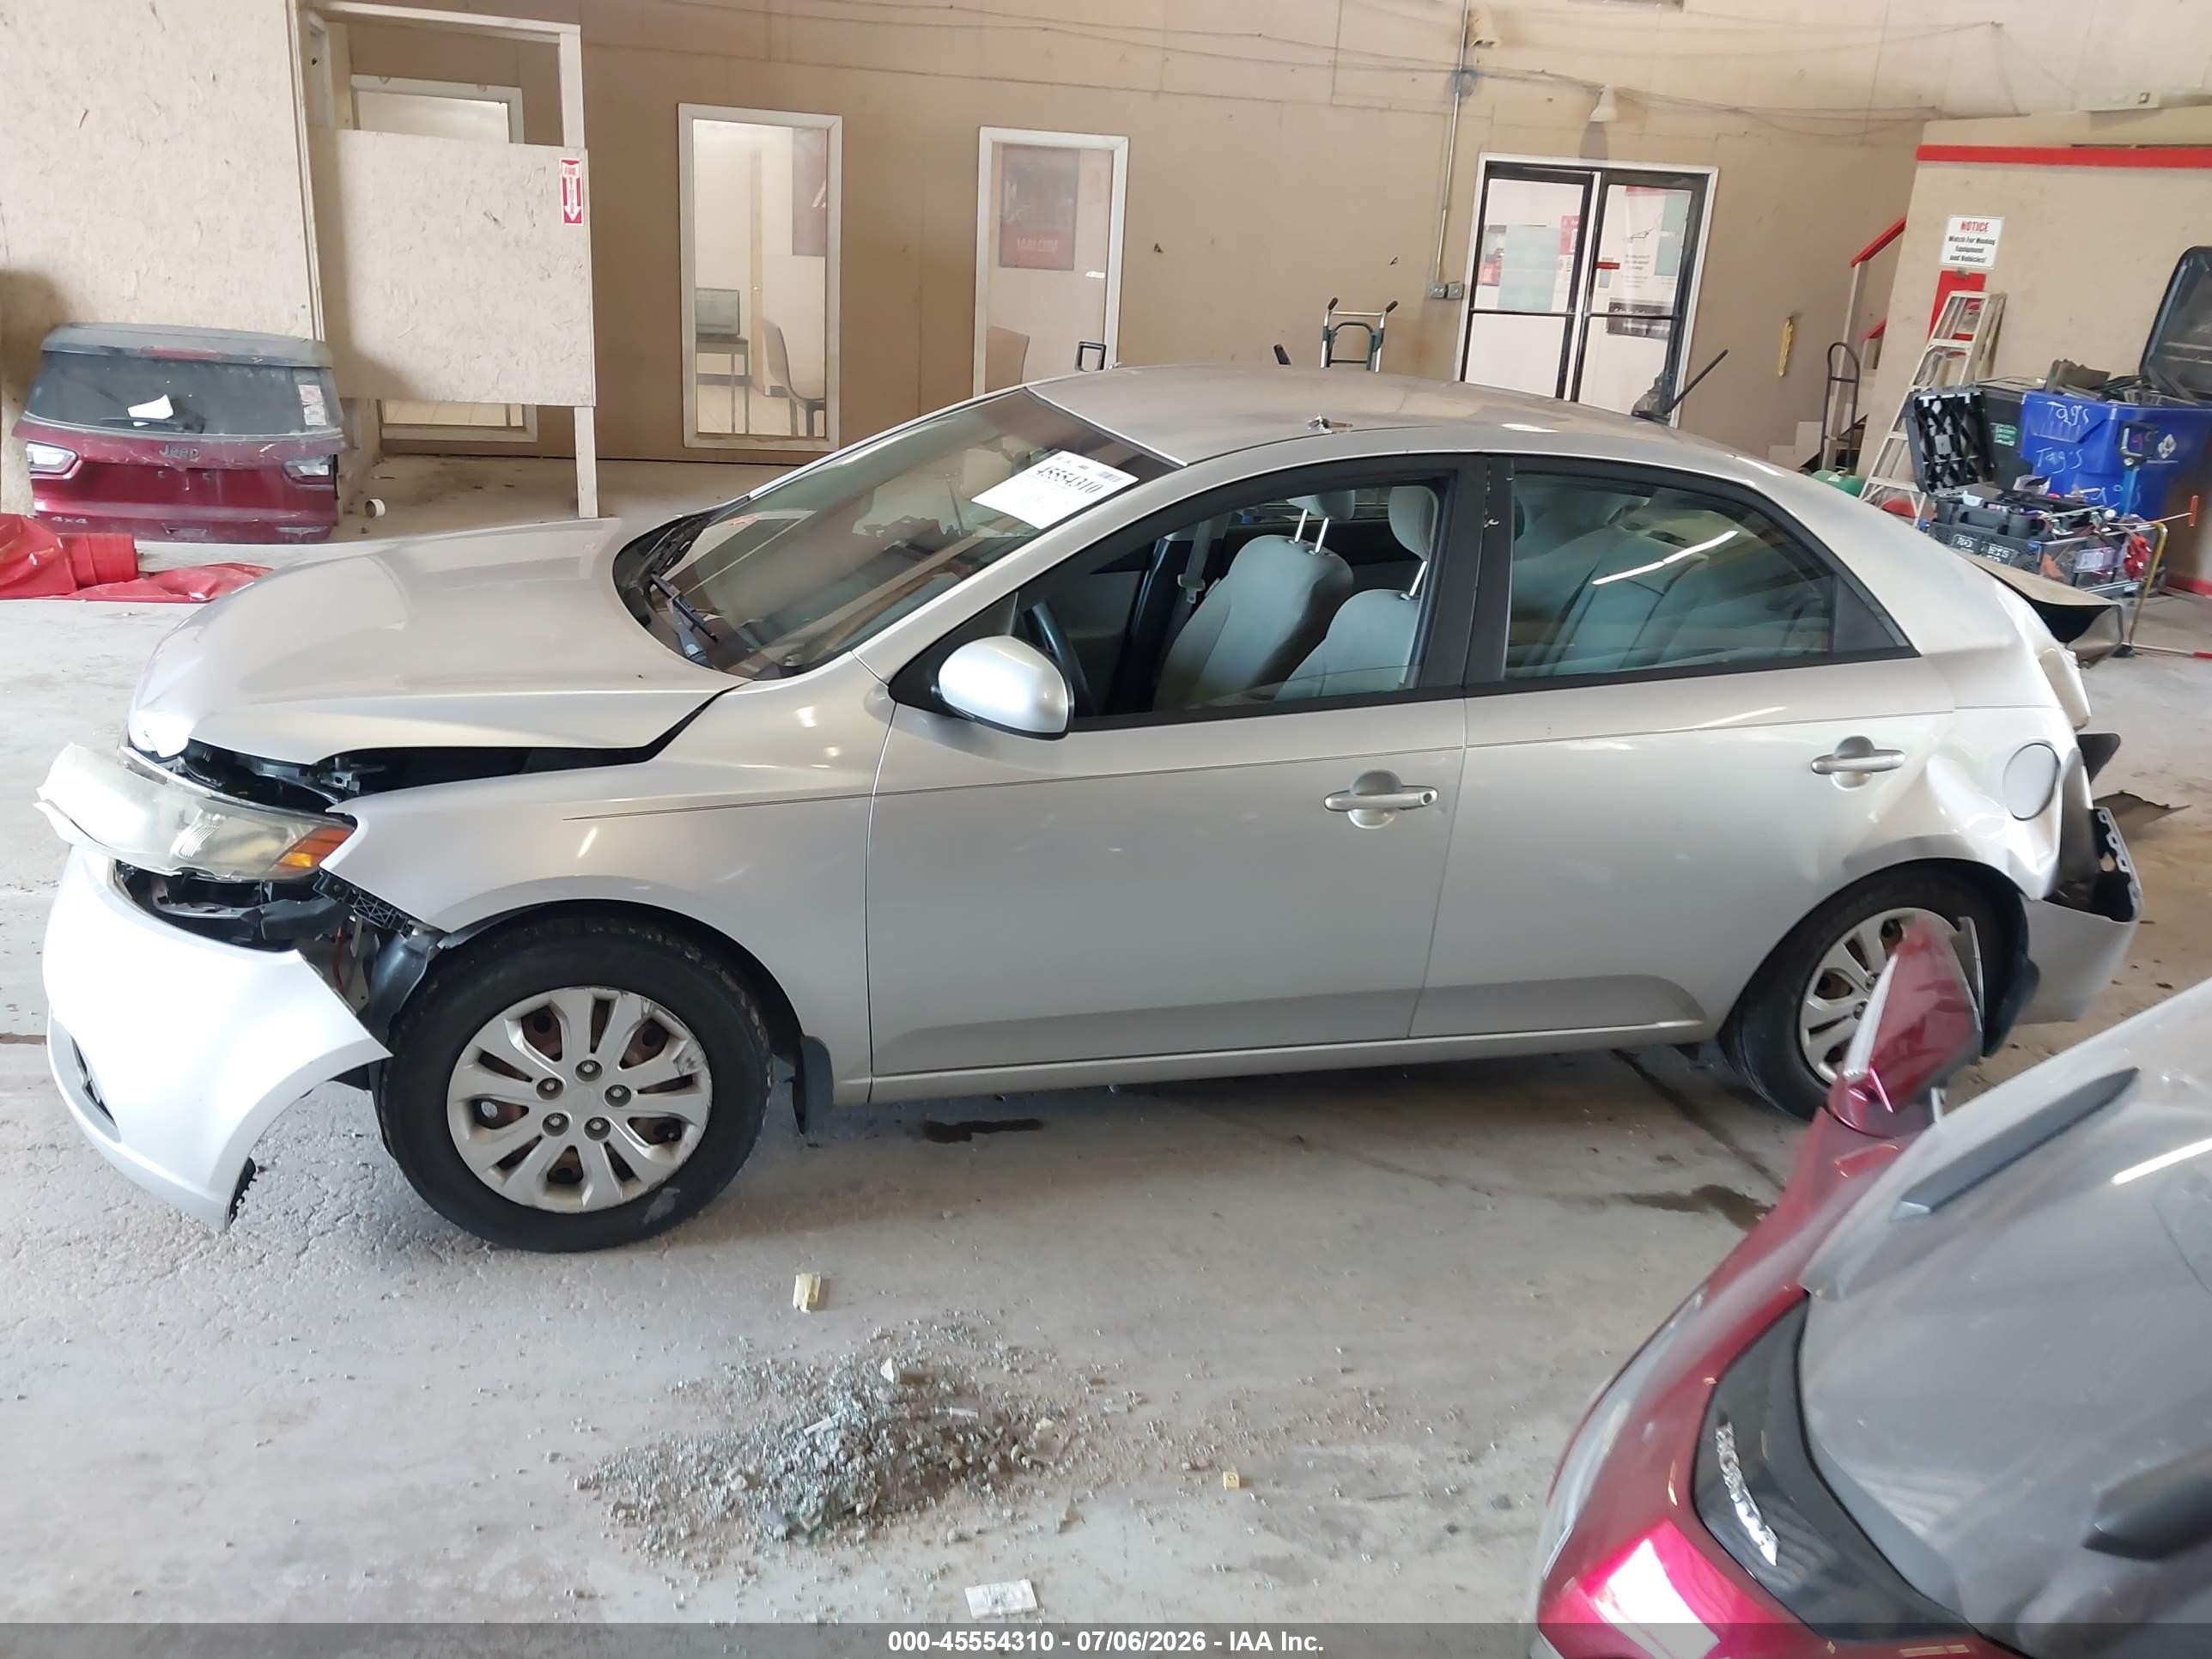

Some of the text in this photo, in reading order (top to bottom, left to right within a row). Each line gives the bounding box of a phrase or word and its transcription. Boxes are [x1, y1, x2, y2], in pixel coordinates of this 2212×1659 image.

[1960, 221, 1990, 232] NOTICE
[159, 444, 201, 463] Jeep
[1036, 465, 1104, 495] 45554310
